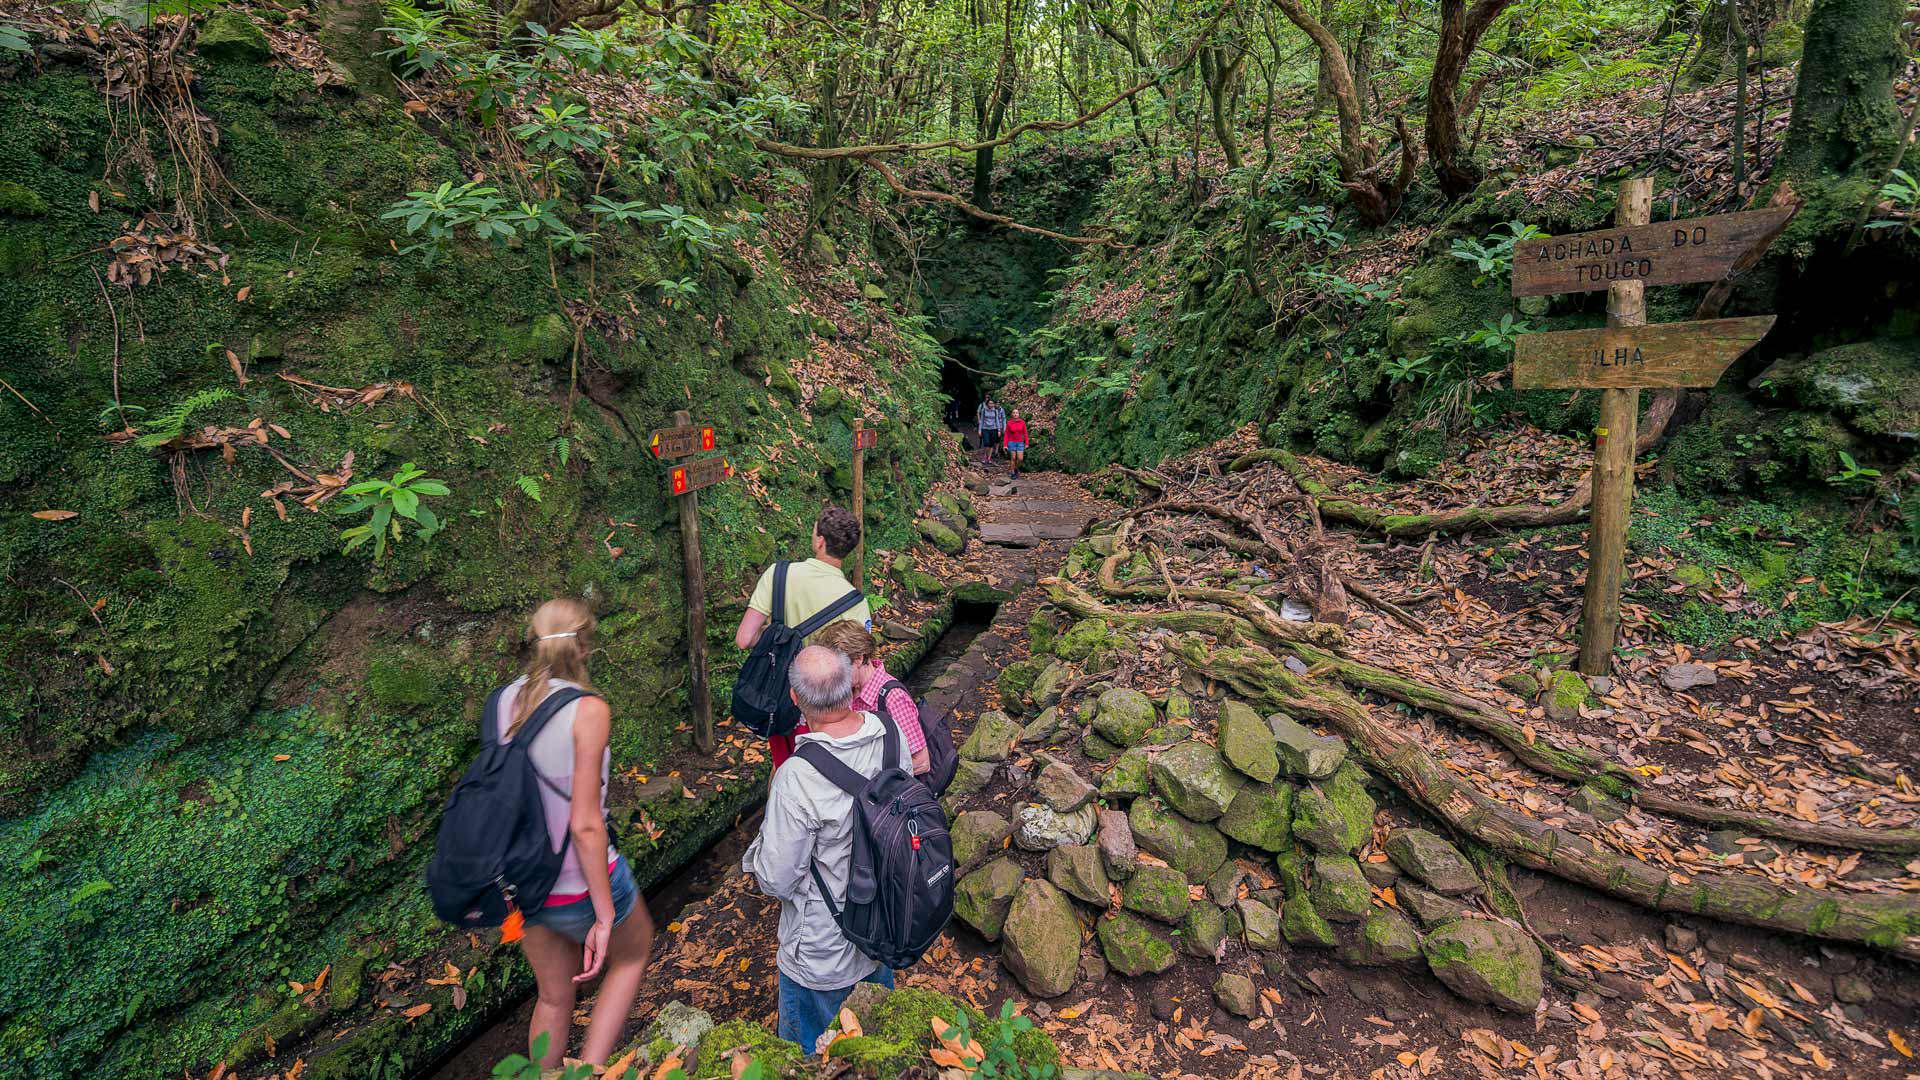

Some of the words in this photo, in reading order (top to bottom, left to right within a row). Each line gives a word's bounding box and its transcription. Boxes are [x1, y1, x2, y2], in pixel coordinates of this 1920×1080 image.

[1537, 235, 1633, 263] ACHADA
[1673, 226, 1707, 248] DO
[1574, 259, 1652, 282] TOUCO
[1593, 347, 1644, 367] ILHA
[674, 470, 682, 479] PR
